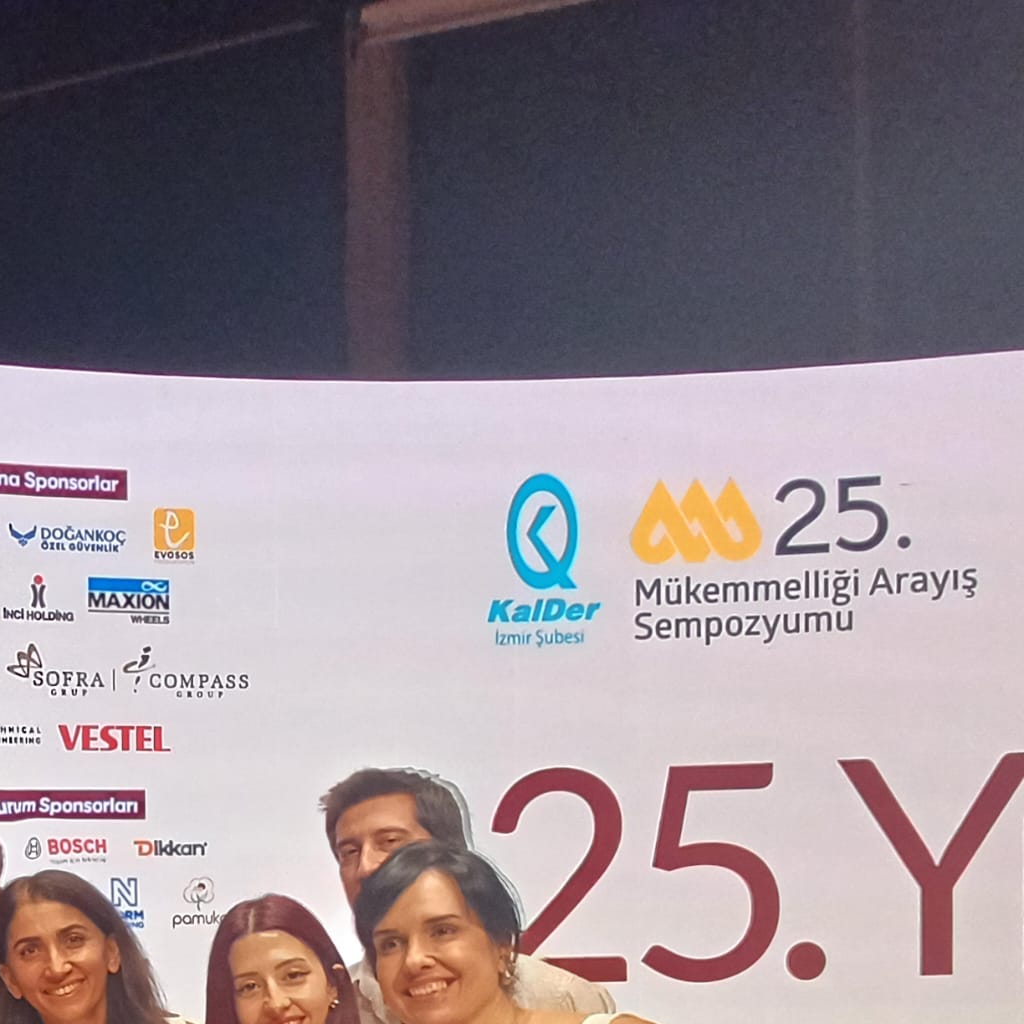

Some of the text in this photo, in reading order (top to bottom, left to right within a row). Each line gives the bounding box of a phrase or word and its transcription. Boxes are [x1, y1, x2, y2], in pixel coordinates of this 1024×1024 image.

[24, 471, 120, 492] Sponsorlar
[775, 475, 912, 556] 25.
[41, 525, 126, 546] DOĞANKOÇ
[41, 541, 120, 552] ÖZEL GÜVENLİK
[154, 551, 195, 560] EVOSOS
[635, 567, 978, 606] Mükemmelliği Arayış
[88, 592, 170, 610] MAXION
[487, 598, 601, 622] KalDer
[130, 614, 170, 625] WHEELS
[634, 609, 854, 646] Sempozyumu
[536, 627, 585, 648] Şubesi
[32, 671, 105, 688] SOFRA
[149, 673, 250, 690] COMPASS
[50, 688, 88, 697] GRUP
[176, 690, 225, 699] GROUP
[58, 725, 172, 752] VESTEL
[39, 797, 138, 816] Sponsorları
[47, 838, 107, 855] BOSCH
